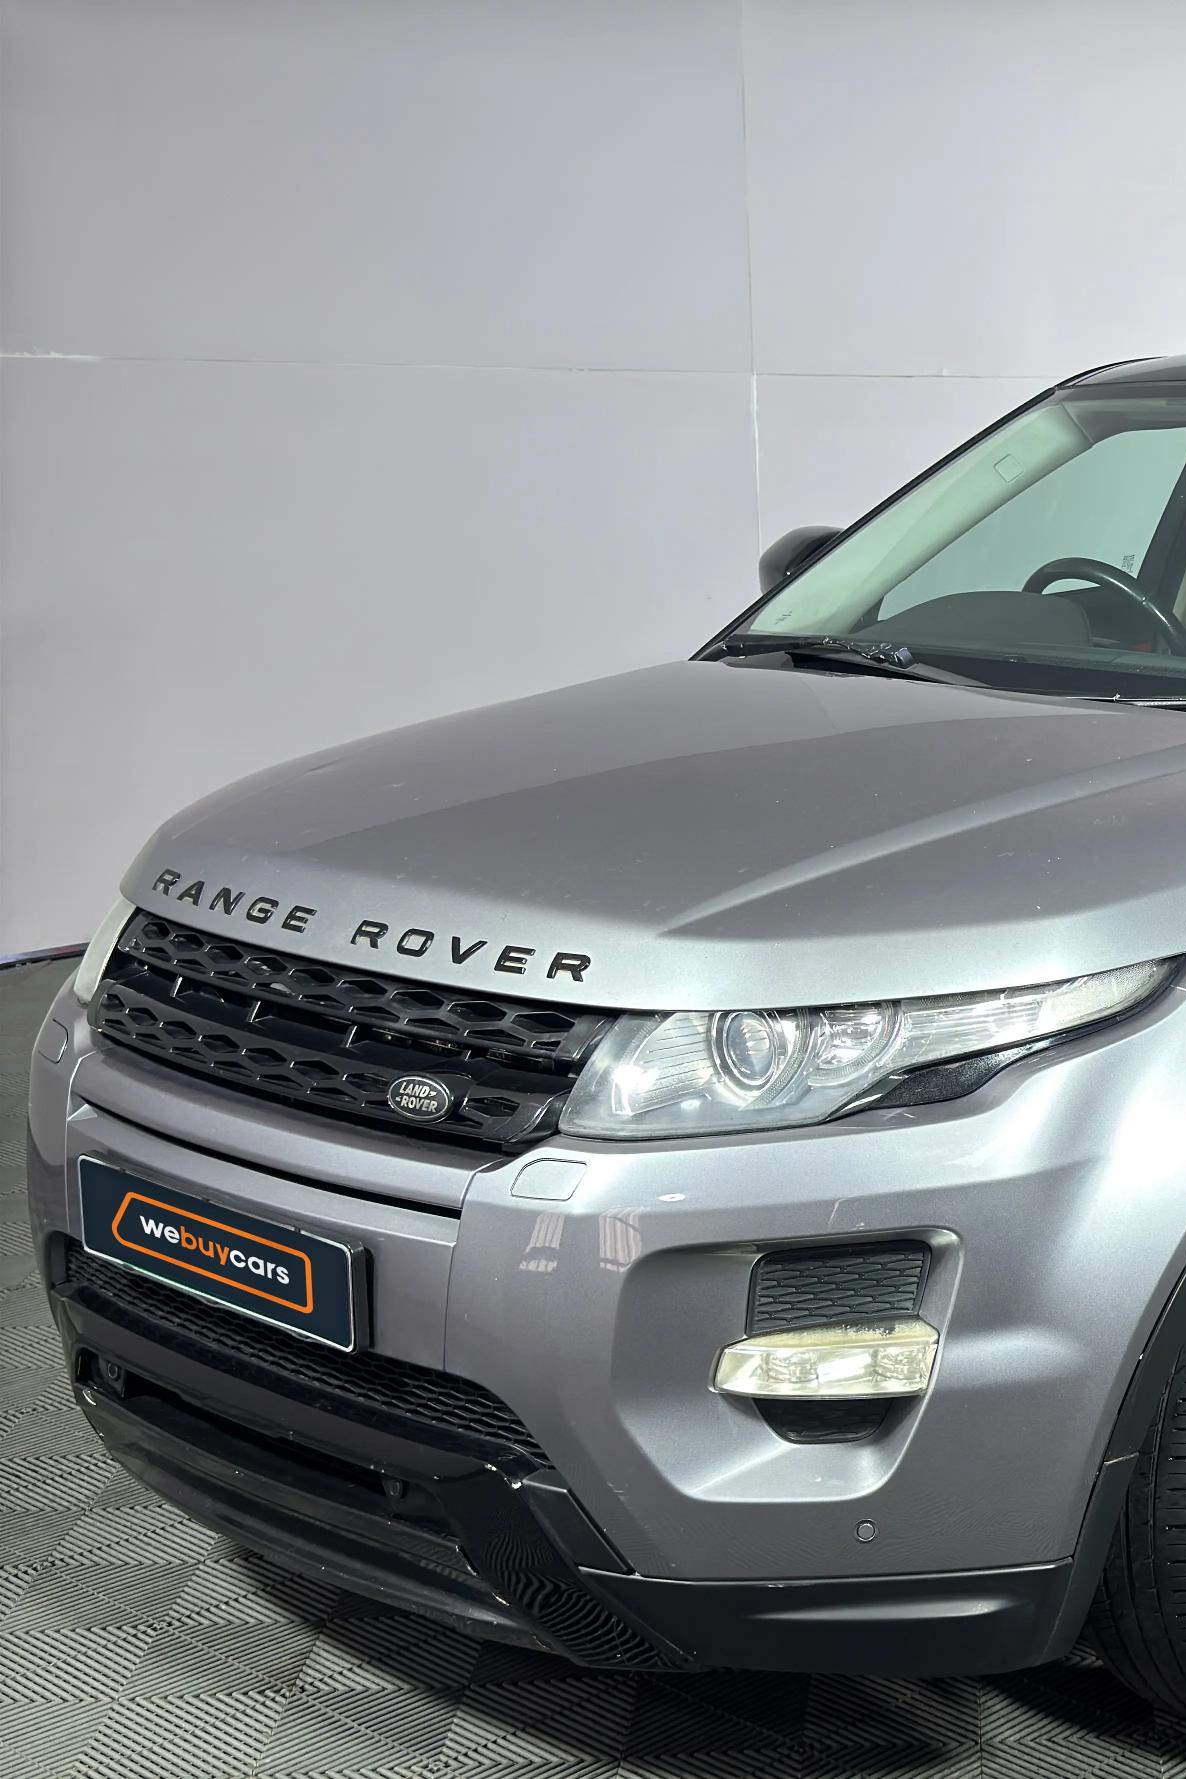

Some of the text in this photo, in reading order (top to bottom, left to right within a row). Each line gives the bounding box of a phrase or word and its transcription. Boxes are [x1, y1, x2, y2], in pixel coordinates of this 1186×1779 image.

[151, 868, 592, 982] RANGE ROVER
[400, 1082, 430, 1097] LAND
[401, 1095, 438, 1112] ROVER
[139, 1216, 290, 1284] webuycars
